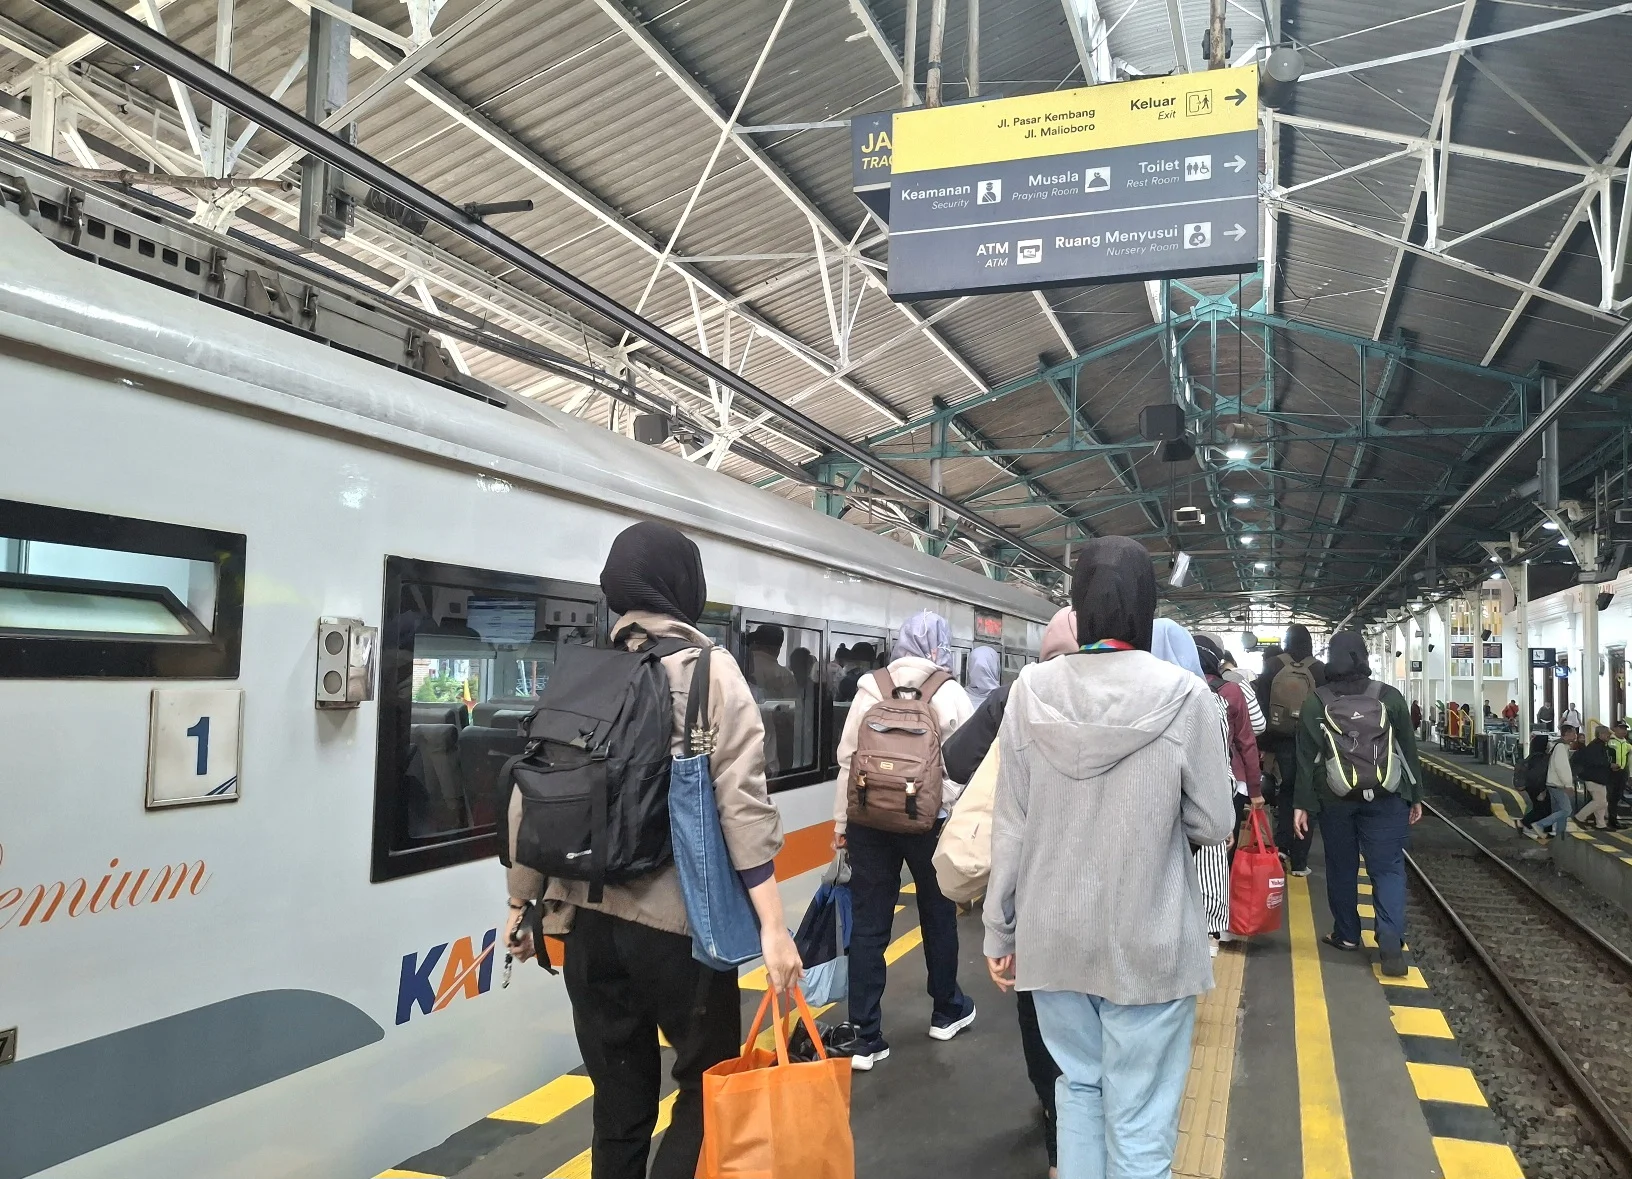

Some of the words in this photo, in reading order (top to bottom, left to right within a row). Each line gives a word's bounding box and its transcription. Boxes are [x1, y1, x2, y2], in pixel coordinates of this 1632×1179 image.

[1130, 96, 1177, 111] Keluar
[997, 118, 1010, 128] Jl.
[1013, 114, 1042, 126] Pasar
[1044, 109, 1096, 122] Kembang
[1157, 110, 1177, 120] Exit
[1024, 129, 1037, 139] Jl.
[1040, 123, 1096, 137] Malioboro
[1138, 159, 1180, 174] Toilet
[1028, 171, 1079, 187] Musala
[1126, 177, 1148, 188] Rest
[1150, 175, 1180, 186] Room
[901, 184, 971, 201] Keamanan
[1011, 189, 1049, 201] Praying
[1051, 185, 1079, 197] Room
[931, 198, 970, 210] Security
[1055, 234, 1101, 249] Ruang
[1105, 225, 1179, 244] Menyusui
[976, 241, 1009, 256] ATM
[1106, 246, 1147, 257] Nursery
[1149, 242, 1179, 253] Room
[985, 256, 1009, 268] ATM
[187, 716, 210, 776] 1
[0, 845, 214, 930] emium
[395, 928, 497, 1026] KAI
